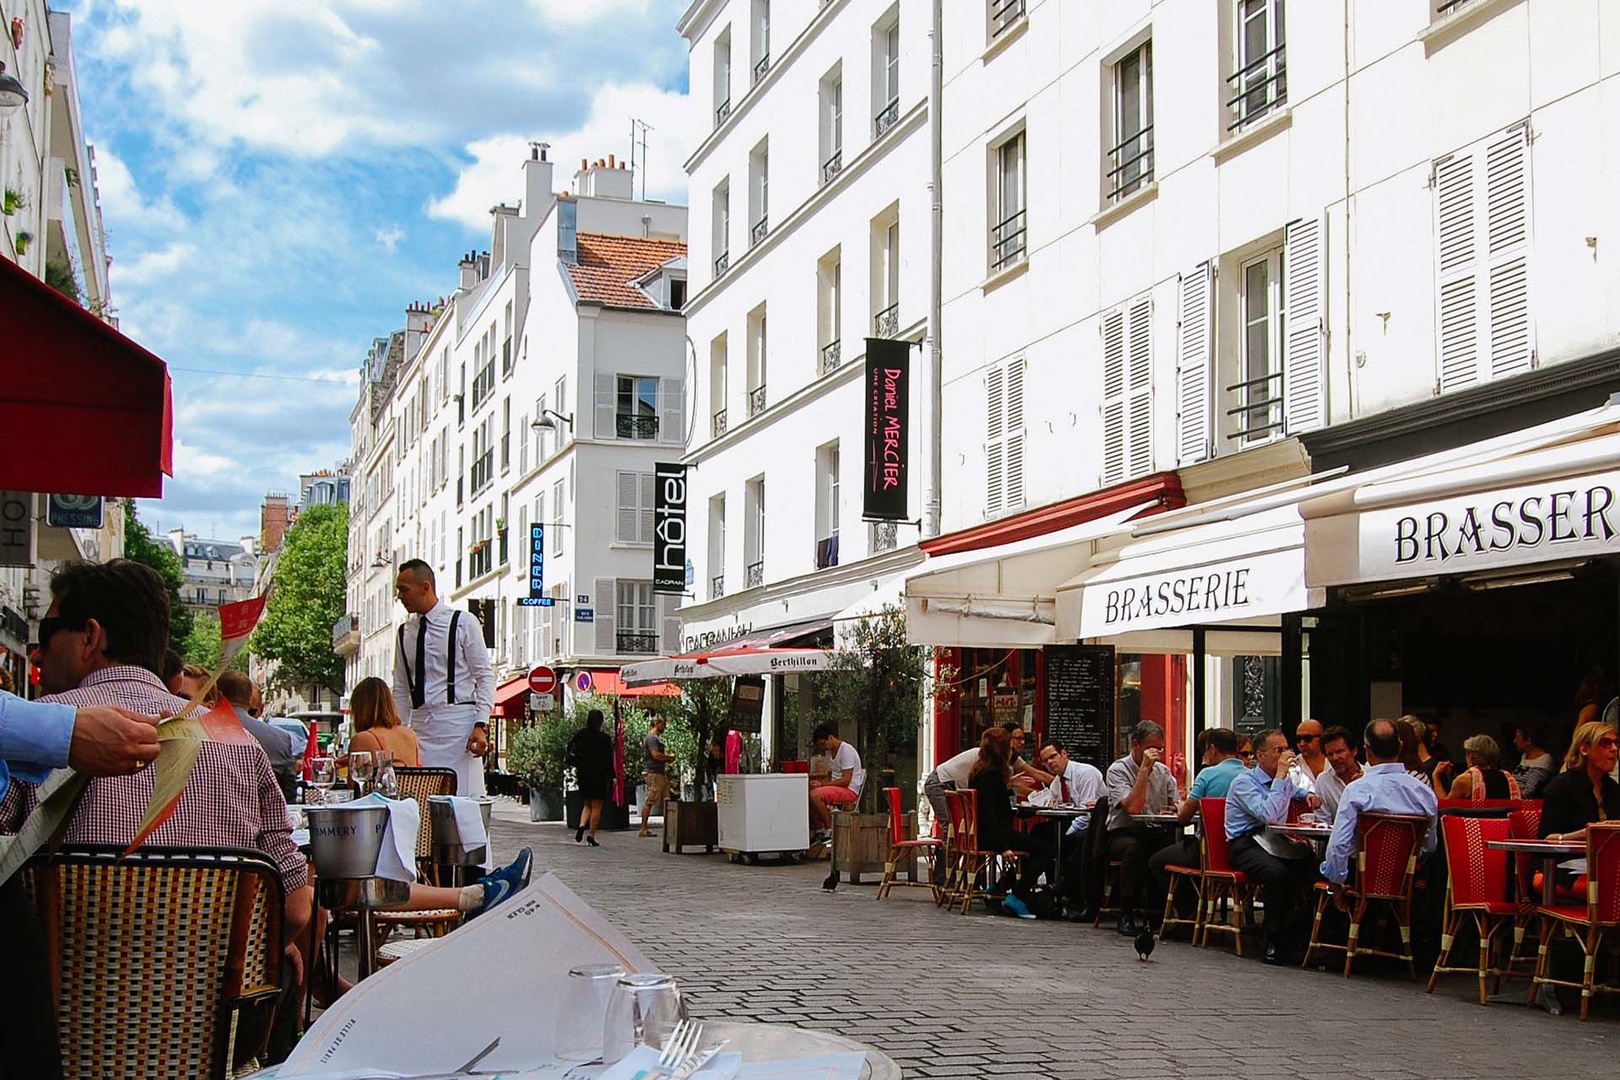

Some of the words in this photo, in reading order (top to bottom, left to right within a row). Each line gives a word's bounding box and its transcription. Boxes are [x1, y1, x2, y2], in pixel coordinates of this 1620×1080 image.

[883, 416, 902, 490] MERCIER
[2, 491, 26, 547] HO
[51, 512, 100, 526] PRESSING
[655, 469, 686, 570] hôtel
[1394, 485, 1618, 563] BRASSER
[522, 598, 552, 606] COFFEE
[1104, 568, 1251, 624] BRASSERIE
[770, 657, 818, 670] Berthillon
